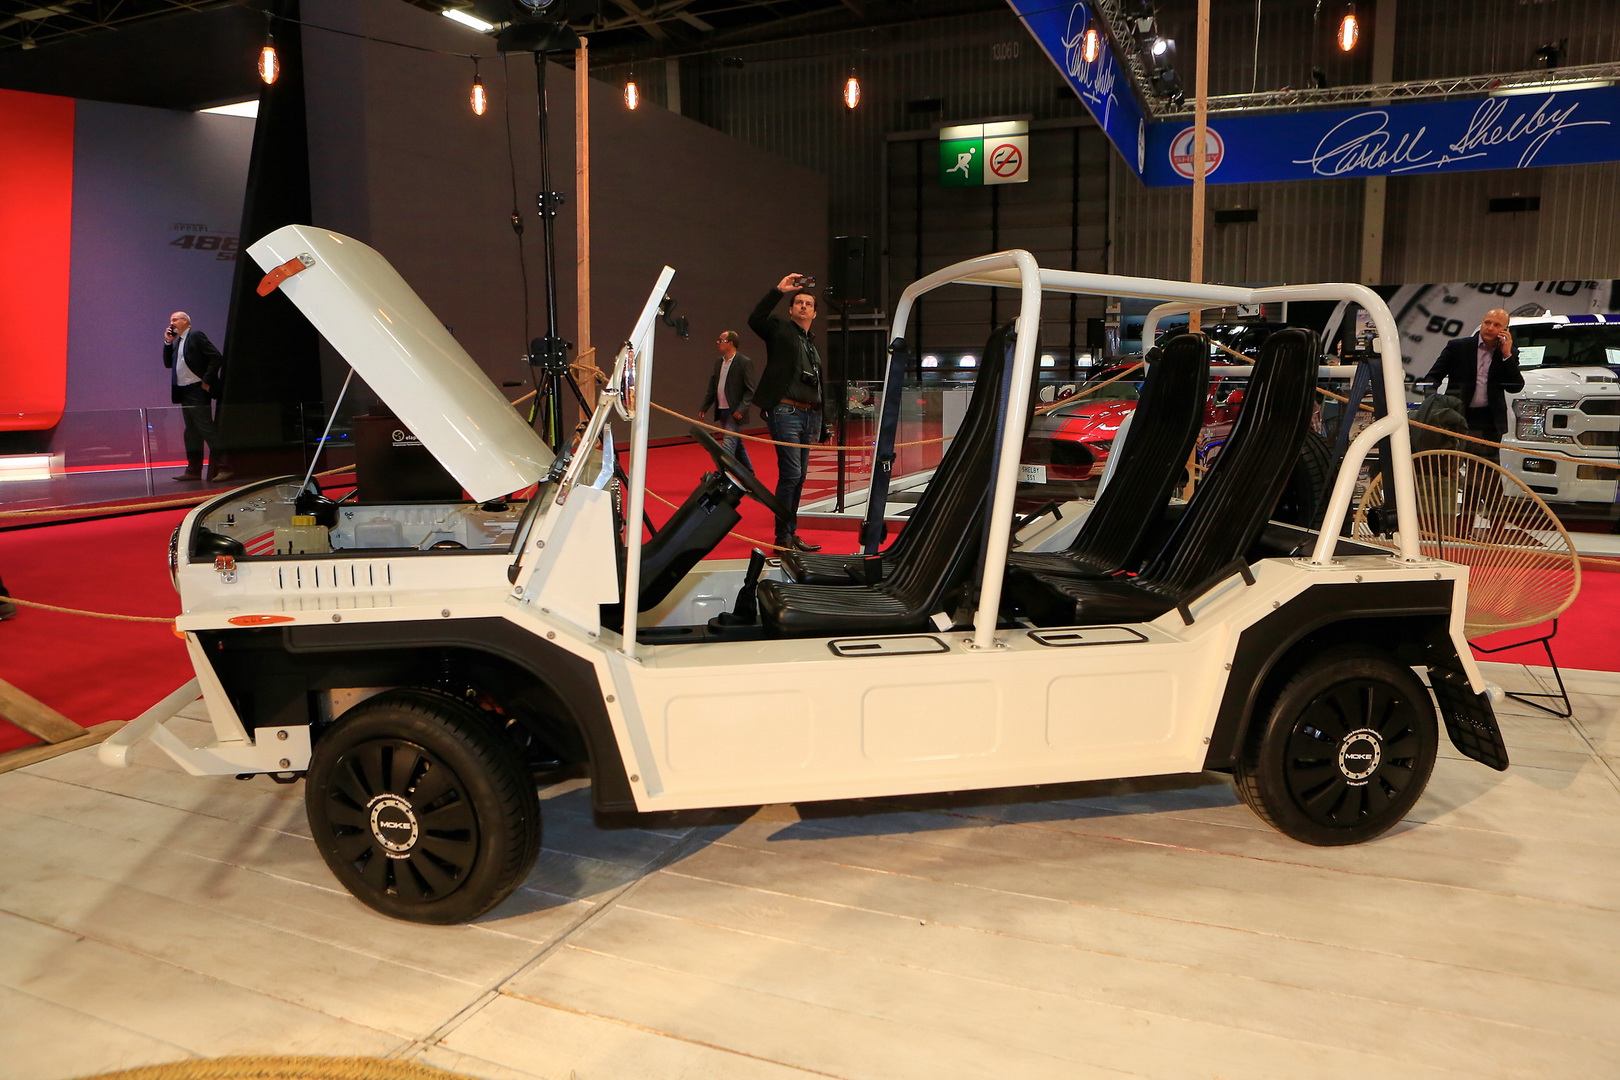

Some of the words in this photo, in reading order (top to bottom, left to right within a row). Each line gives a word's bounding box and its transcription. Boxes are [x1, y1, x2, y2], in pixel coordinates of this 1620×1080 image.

[1449, 94, 1611, 168] Shelby
[1174, 153, 1219, 164] SHEBY
[1021, 466, 1040, 474] SHELBY
[380, 820, 411, 830] MOKE
